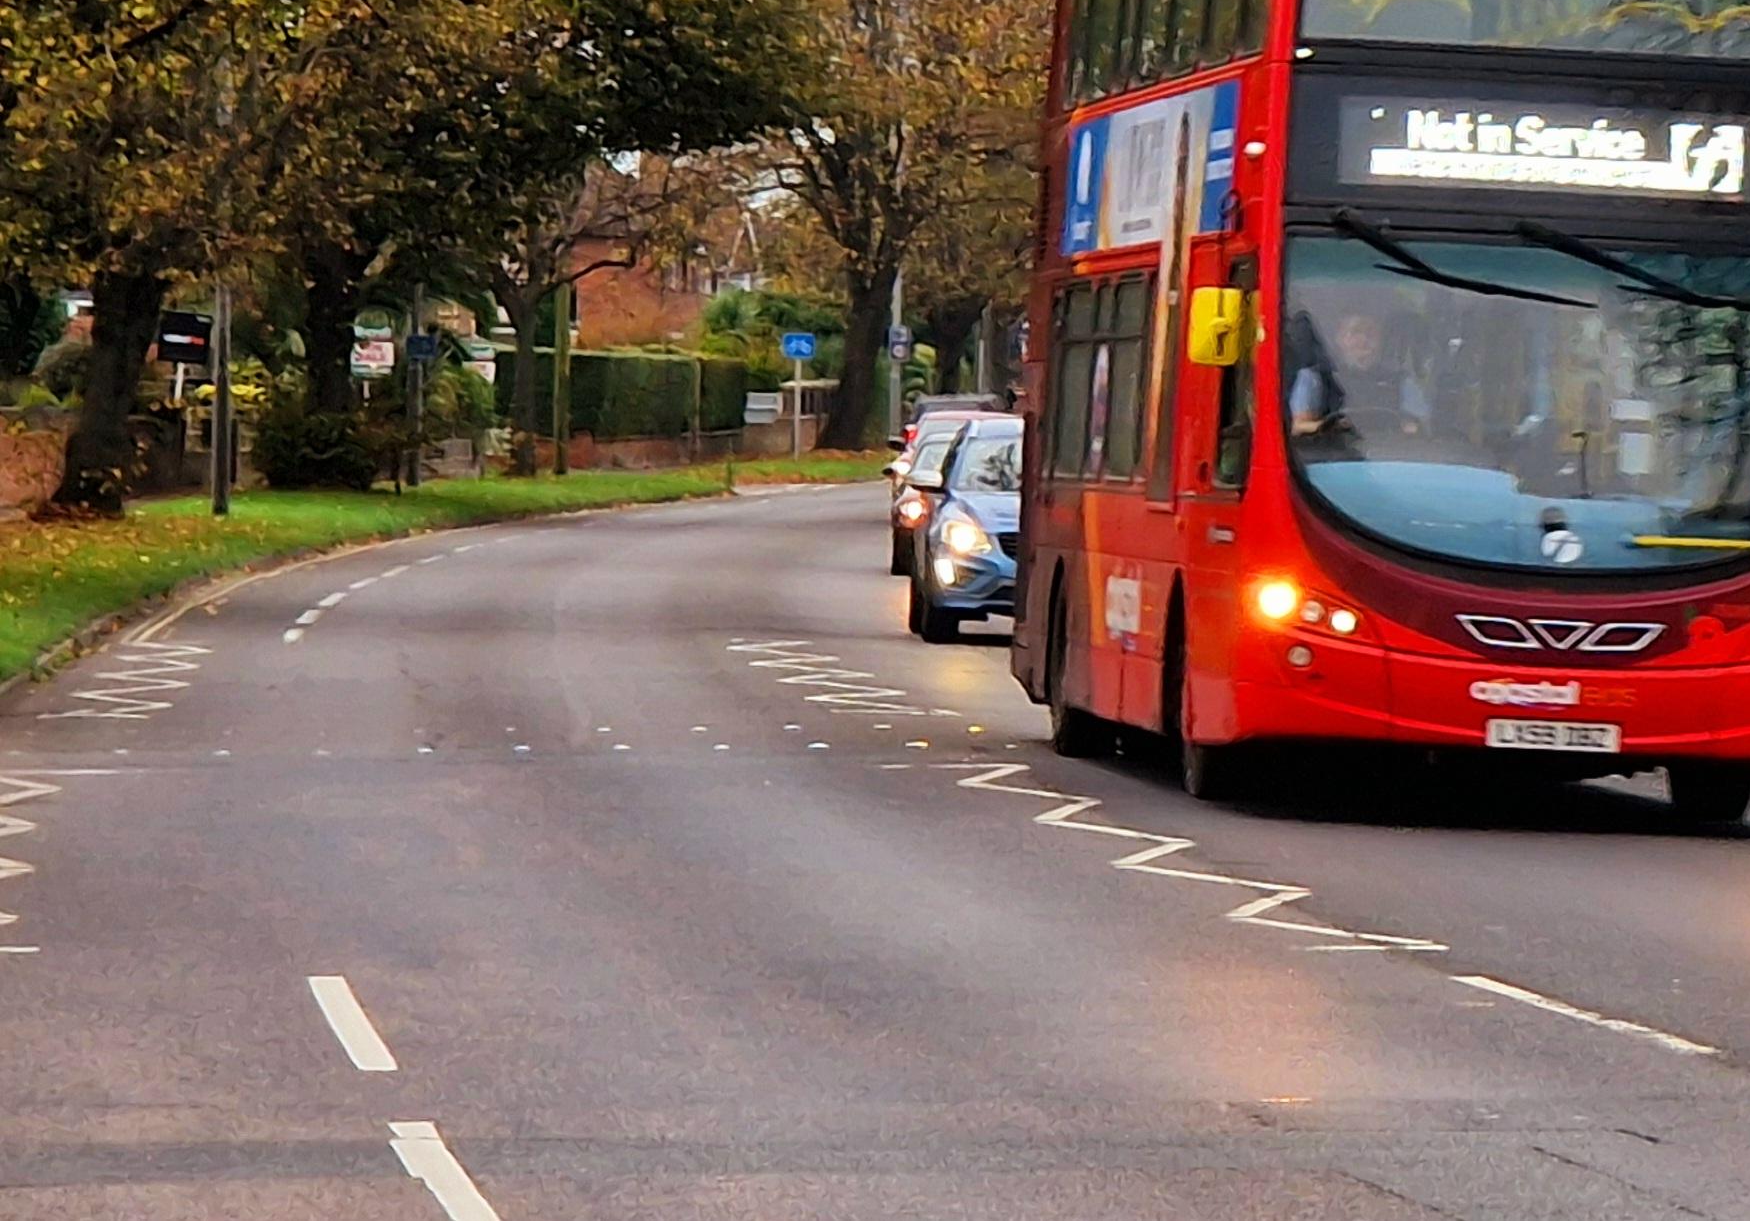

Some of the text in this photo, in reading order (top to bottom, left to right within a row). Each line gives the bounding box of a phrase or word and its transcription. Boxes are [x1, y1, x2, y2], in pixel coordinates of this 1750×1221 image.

[1407, 109, 1474, 150] Not
[1477, 112, 1511, 154] in
[1515, 114, 1646, 161] Service
